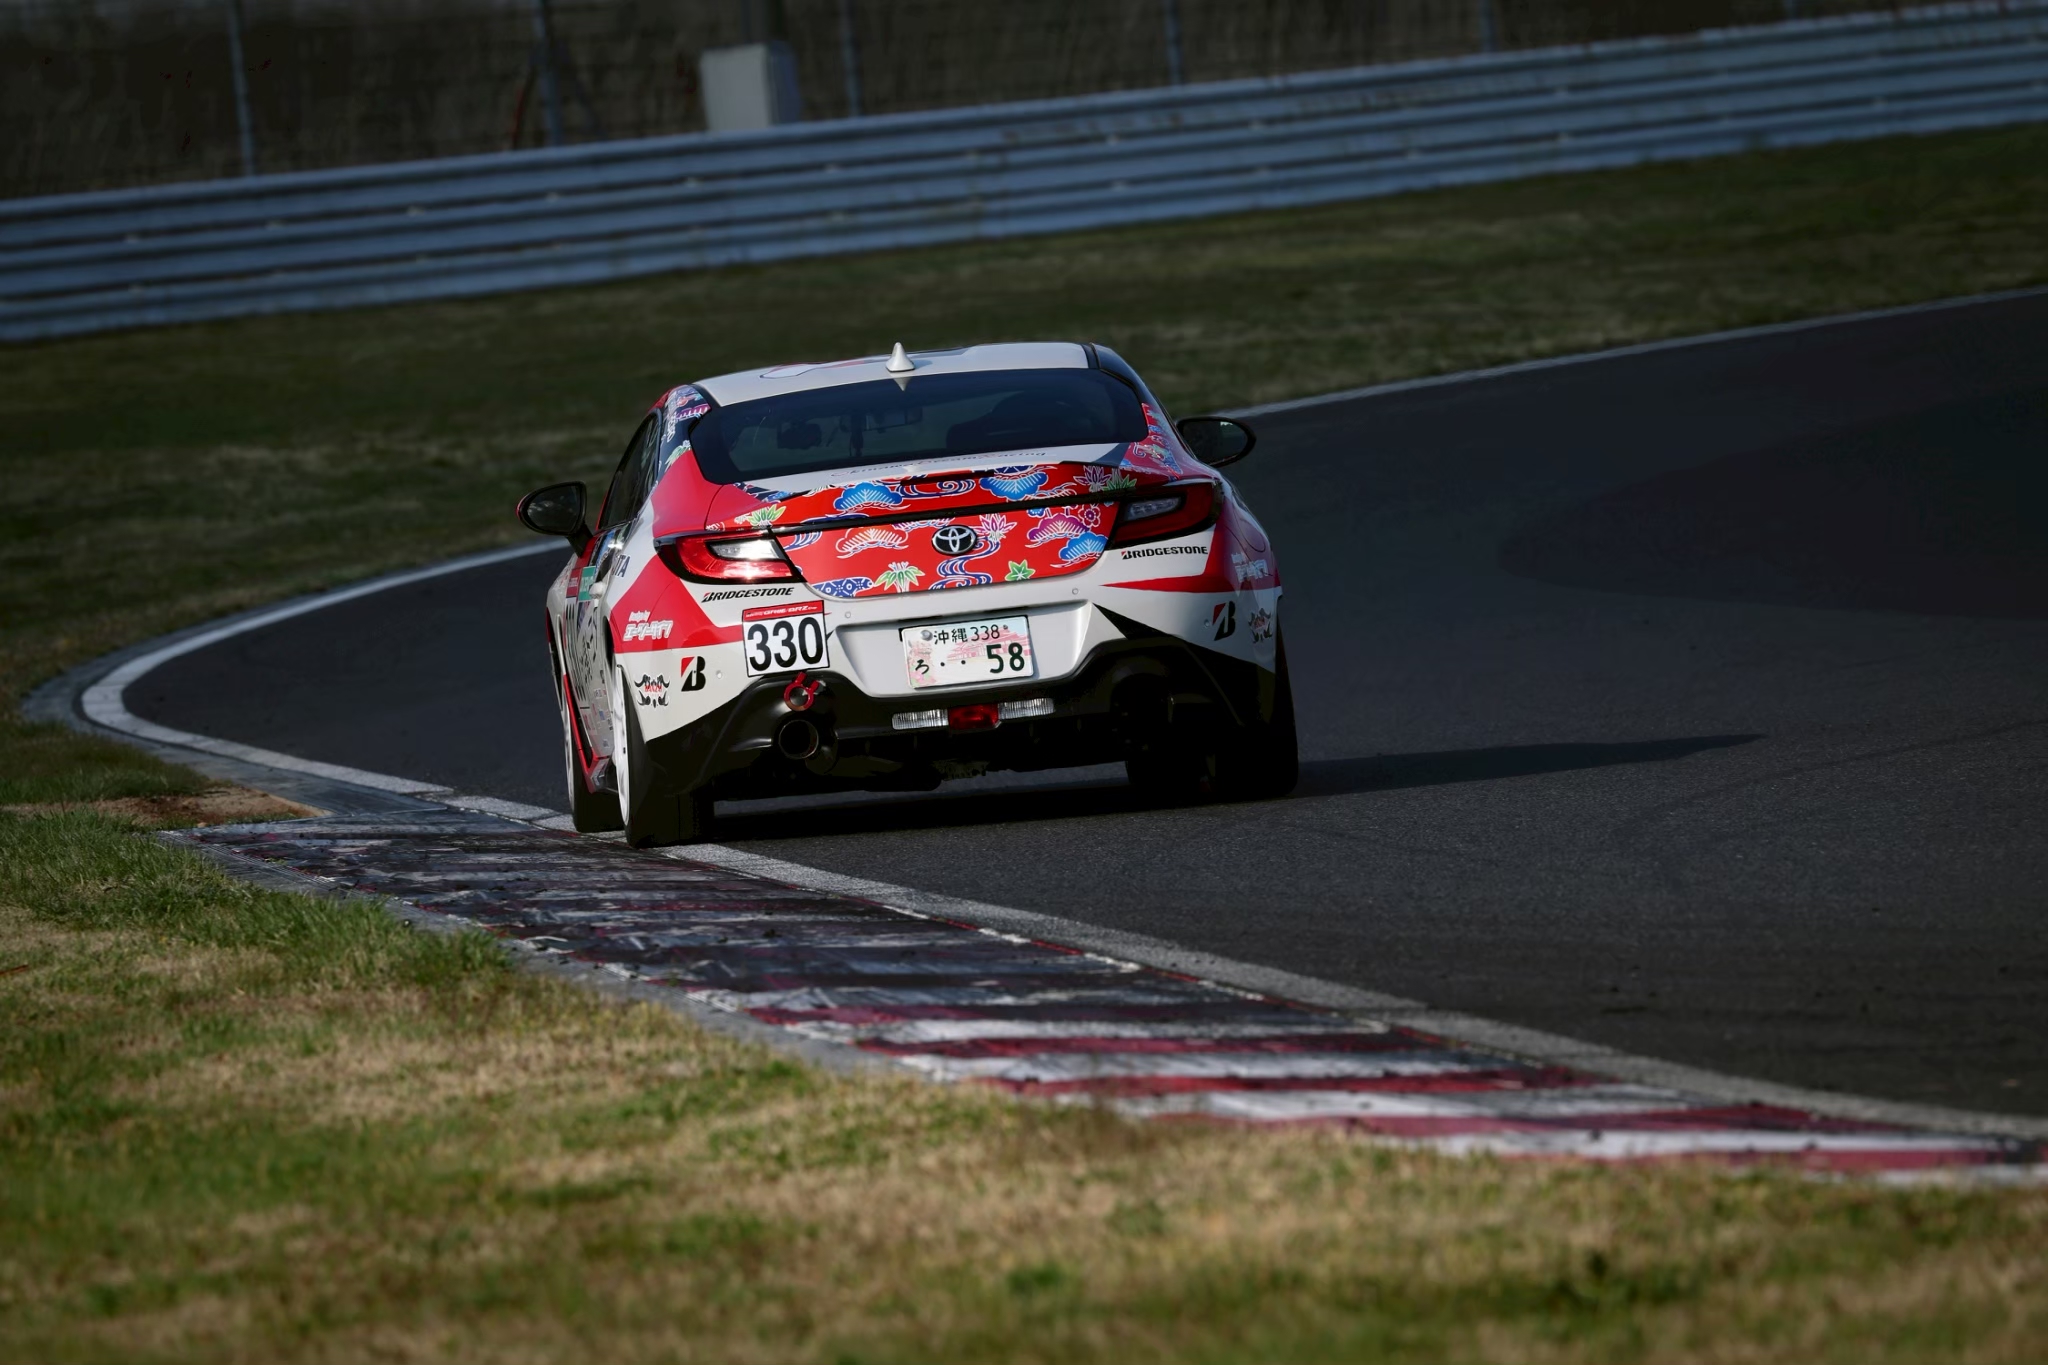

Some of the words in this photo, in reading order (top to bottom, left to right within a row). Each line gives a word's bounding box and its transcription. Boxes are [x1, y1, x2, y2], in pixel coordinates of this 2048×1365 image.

[1121, 546, 1208, 560] BRIDGESTONE
[701, 587, 795, 603] BRIDGESTONE
[933, 628, 968, 645] 沖縄
[970, 624, 1000, 641] 338
[747, 617, 824, 671] 330
[915, 659, 930, 674] ろ
